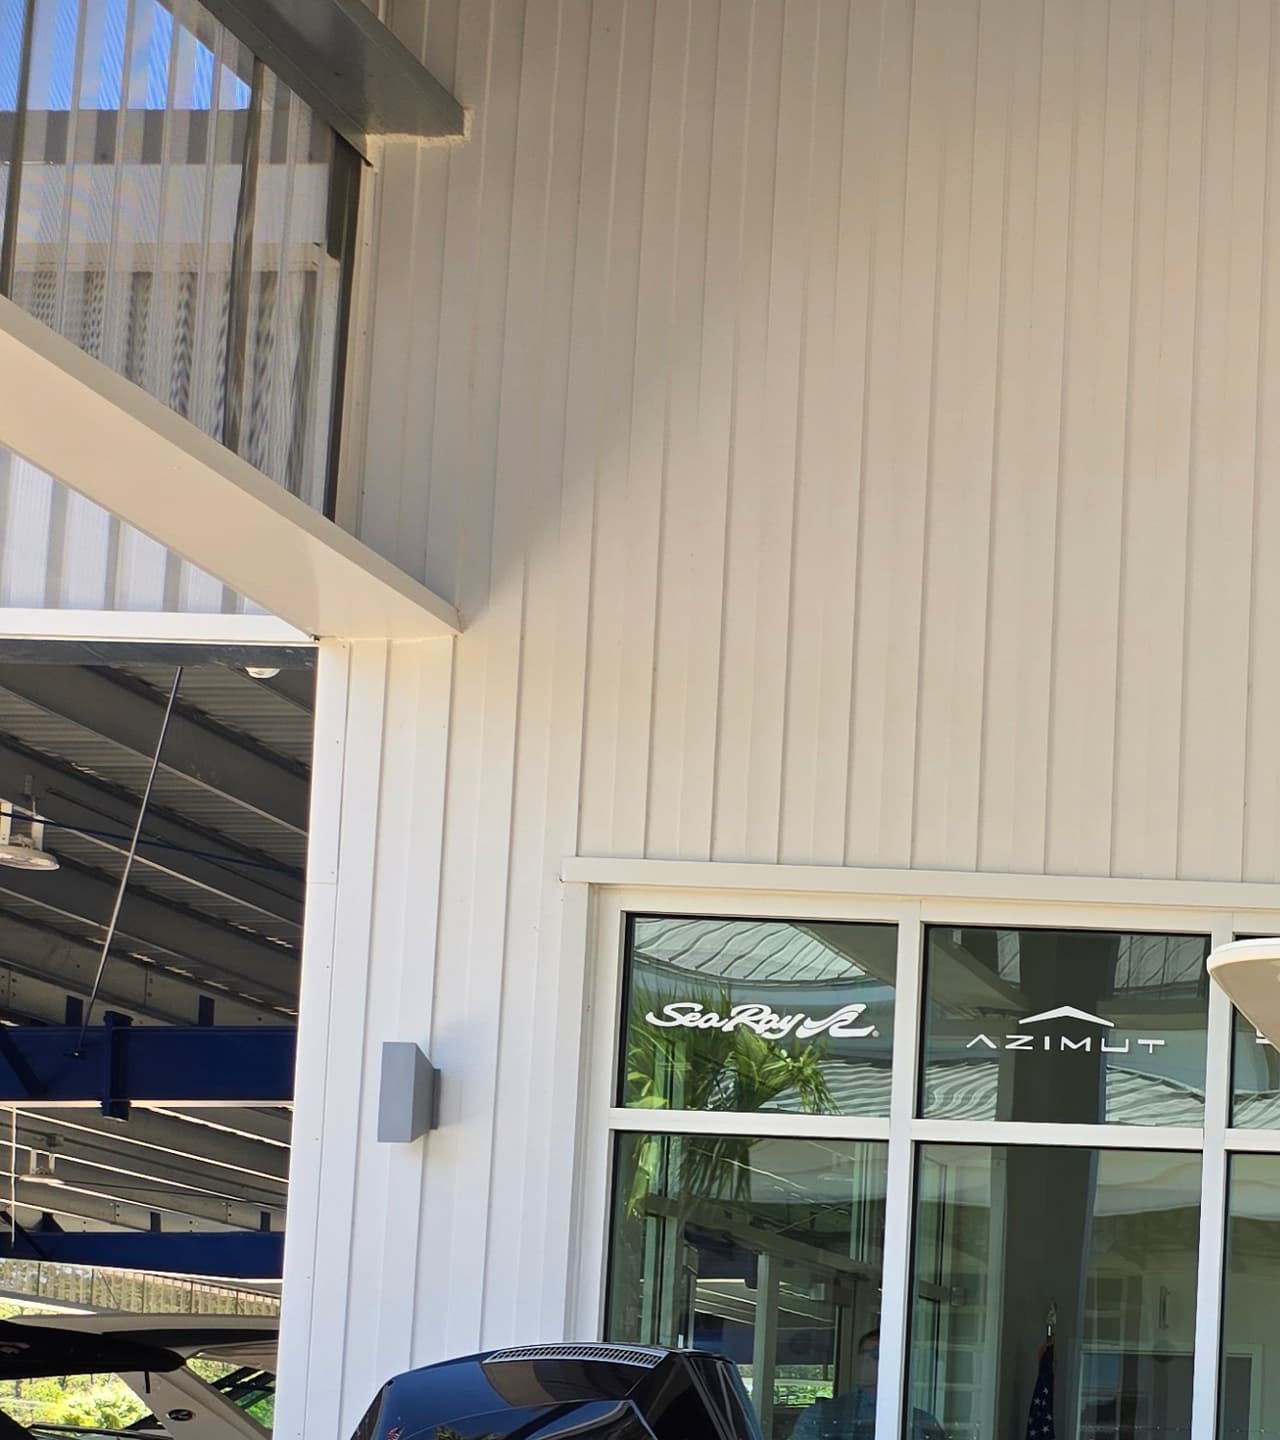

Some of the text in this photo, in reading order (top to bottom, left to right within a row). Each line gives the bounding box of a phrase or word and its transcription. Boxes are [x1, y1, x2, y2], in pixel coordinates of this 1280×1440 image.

[645, 1002, 806, 1040] Sea Ray
[966, 1033, 1165, 1054] AZIMUT
